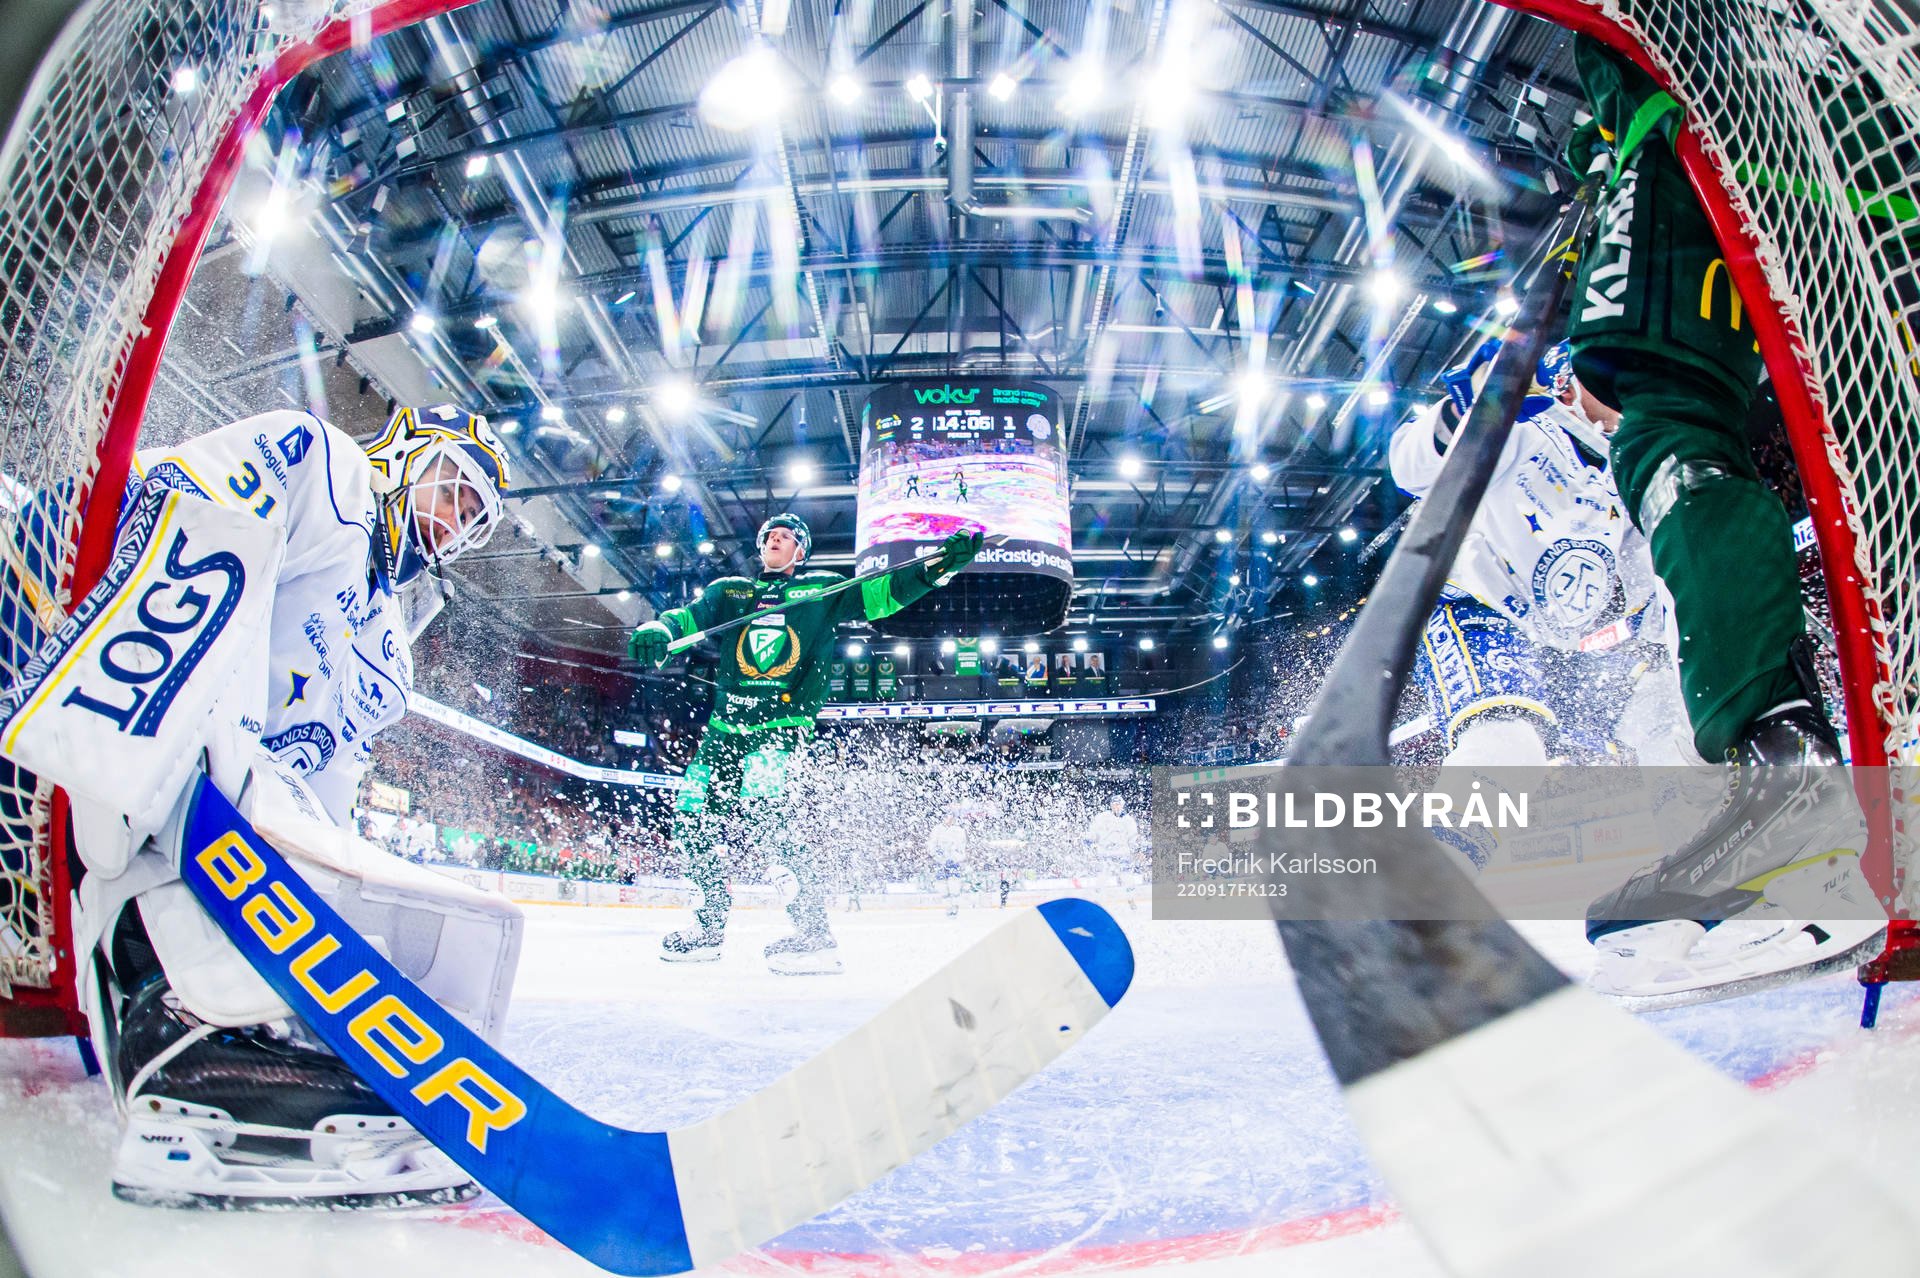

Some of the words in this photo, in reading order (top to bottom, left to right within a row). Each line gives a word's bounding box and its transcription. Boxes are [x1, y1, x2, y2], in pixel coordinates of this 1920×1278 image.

[911, 416, 924, 431] 2
[1003, 416, 1016, 431] 1
[226, 460, 278, 520] 31
[61, 528, 246, 738] LOGS
[196, 829, 528, 1155] BAUER
